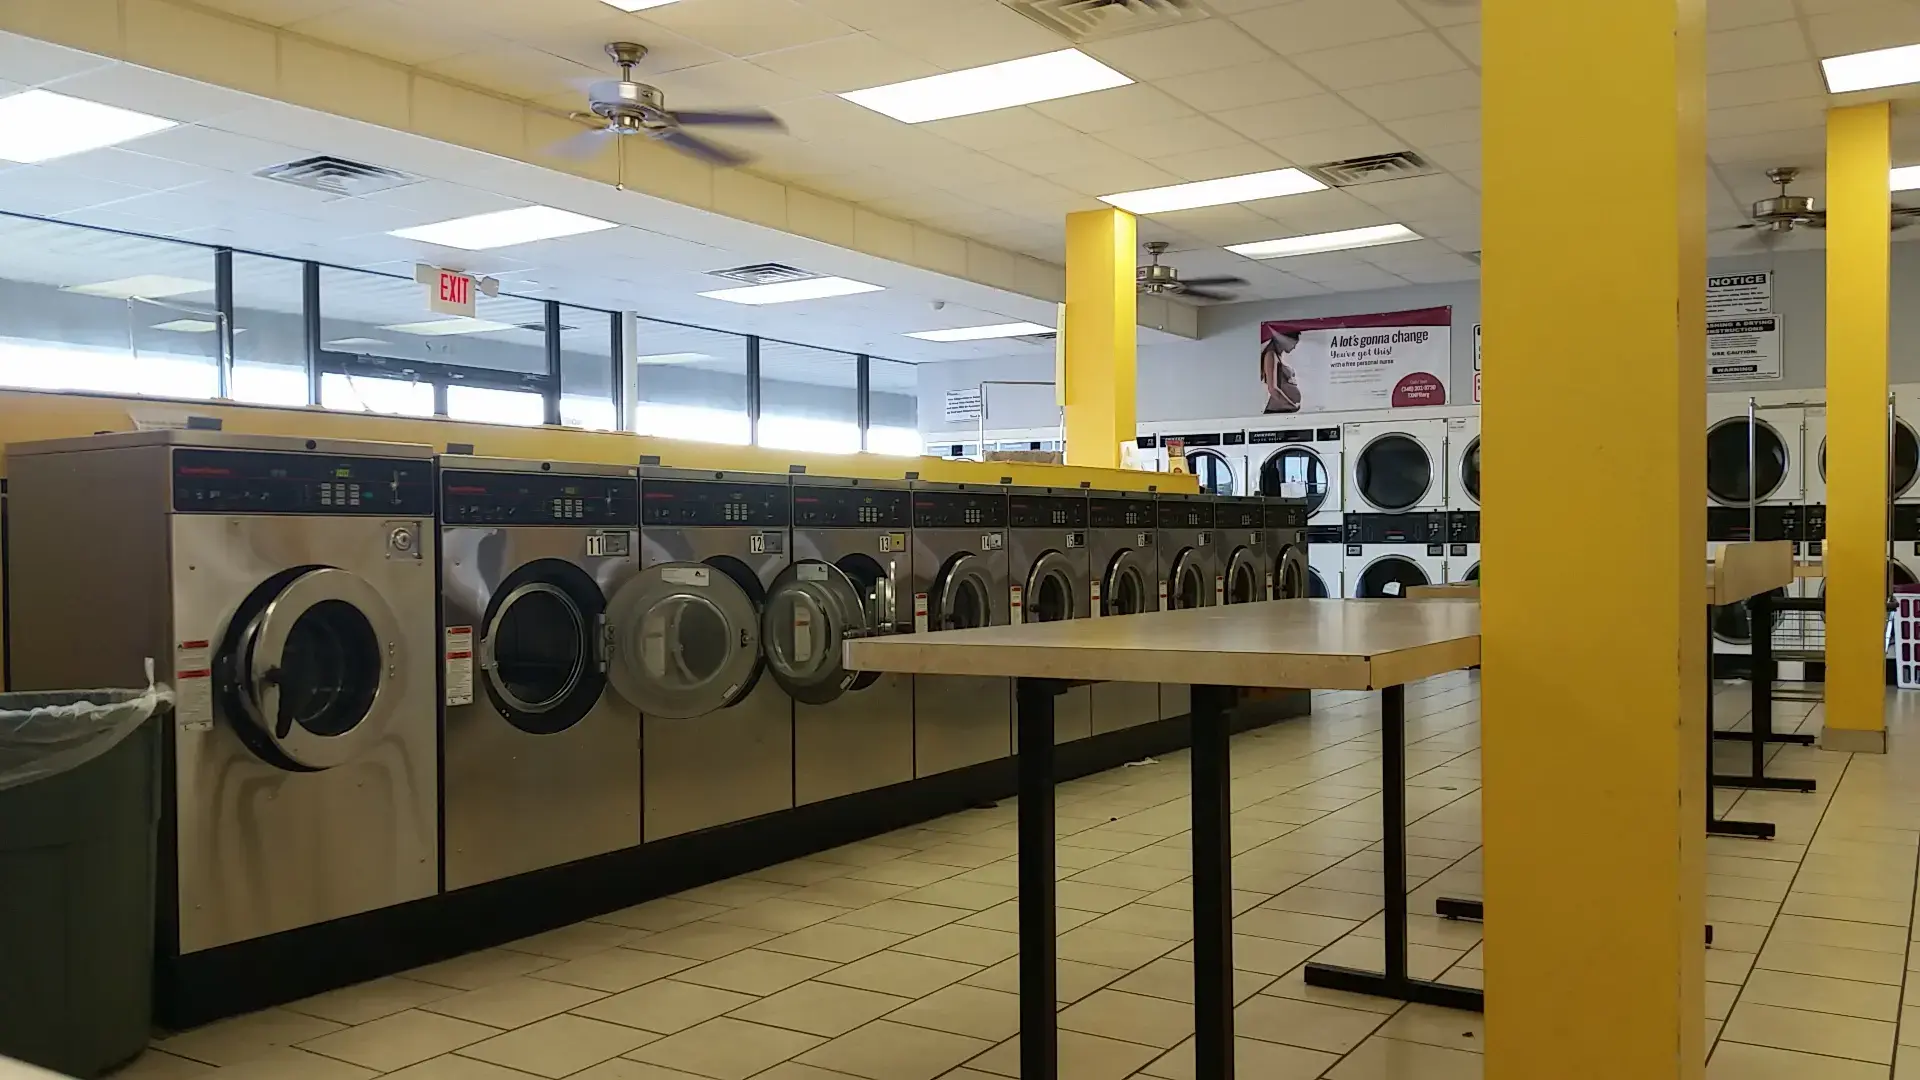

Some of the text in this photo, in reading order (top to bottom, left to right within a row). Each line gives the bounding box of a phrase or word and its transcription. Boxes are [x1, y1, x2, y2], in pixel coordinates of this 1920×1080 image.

[440, 273, 469, 304] EXIT
[1710, 275, 1764, 287] NOTICE
[1330, 330, 1429, 348] A lot's gonna change
[1330, 346, 1392, 360] You've got this!
[1356, 359, 1379, 368] personal
[589, 537, 601, 554] 11
[752, 536, 762, 552] 12
[881, 537, 889, 551] 13
